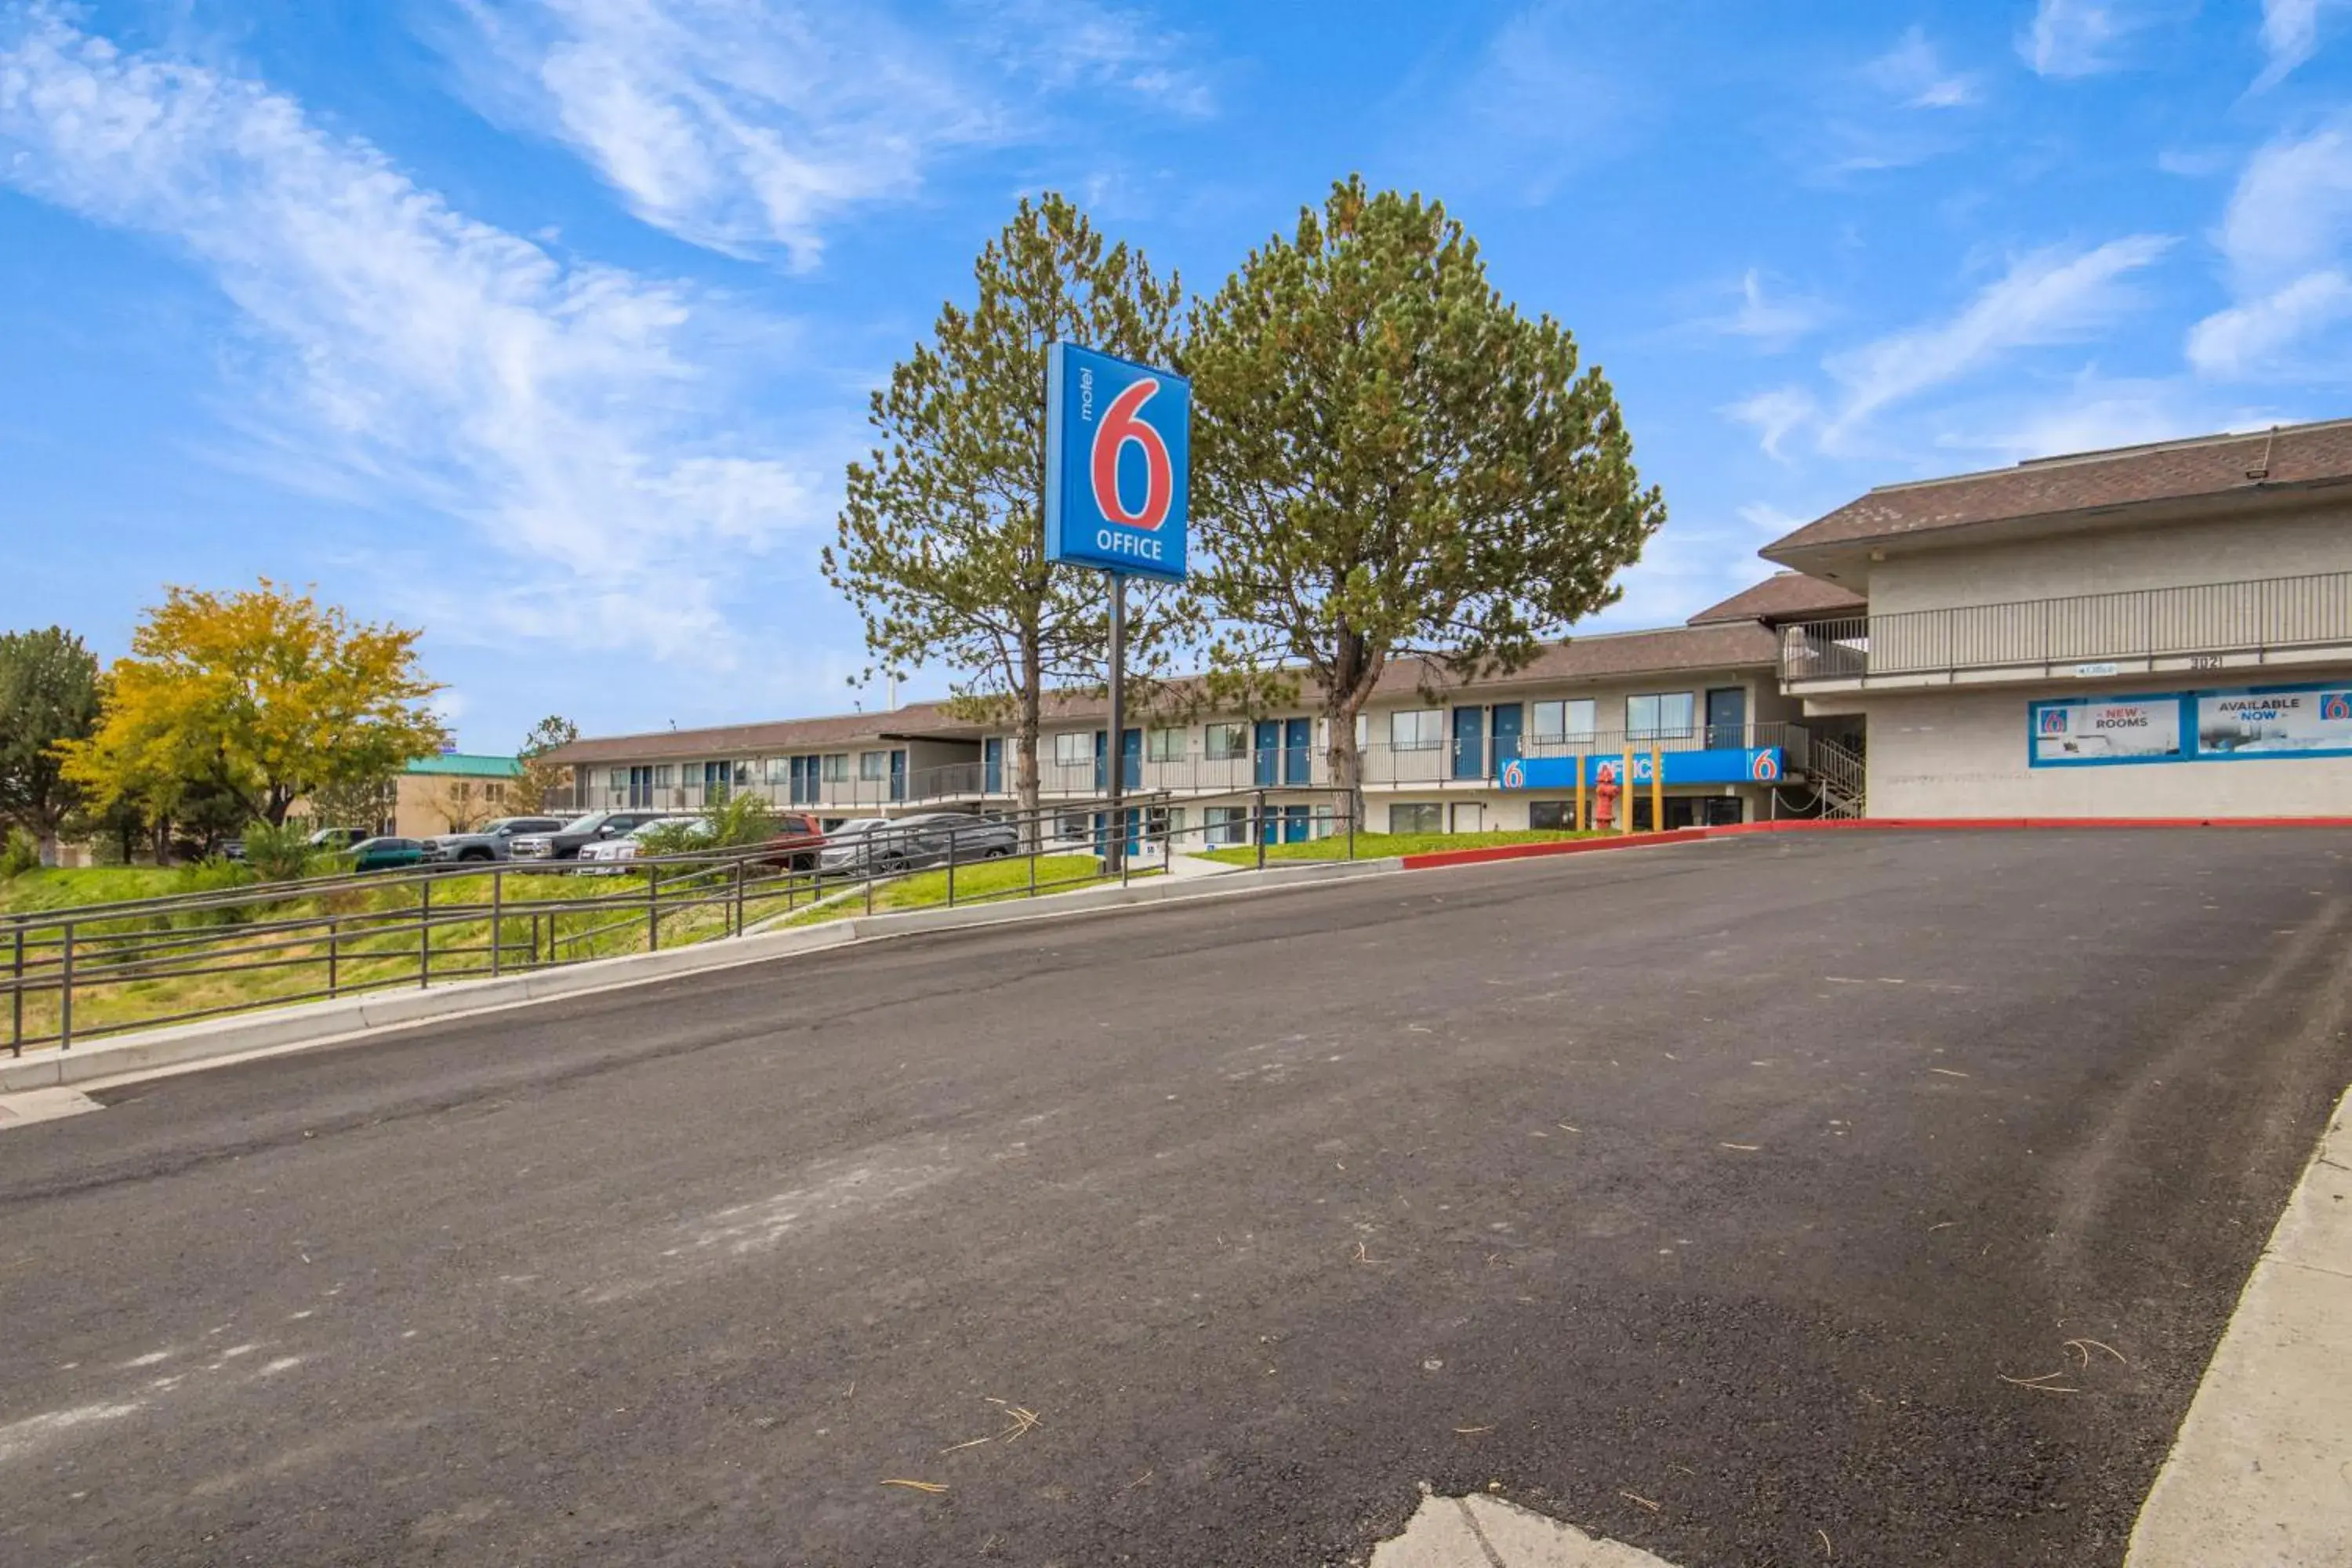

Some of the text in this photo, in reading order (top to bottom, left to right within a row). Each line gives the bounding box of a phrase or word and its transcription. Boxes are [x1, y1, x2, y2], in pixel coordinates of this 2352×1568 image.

[1080, 367, 1092, 422] motel
[1091, 377, 1174, 532] 6
[1097, 528, 1163, 561] OFFICE
[2106, 708, 2138, 718] NEW
[2220, 699, 2299, 711] AVAILABLE
[2240, 711, 2277, 720] NOW
[2096, 717, 2148, 728] ROOMS
[1504, 760, 1523, 788] 6
[1753, 749, 1777, 780] 6
